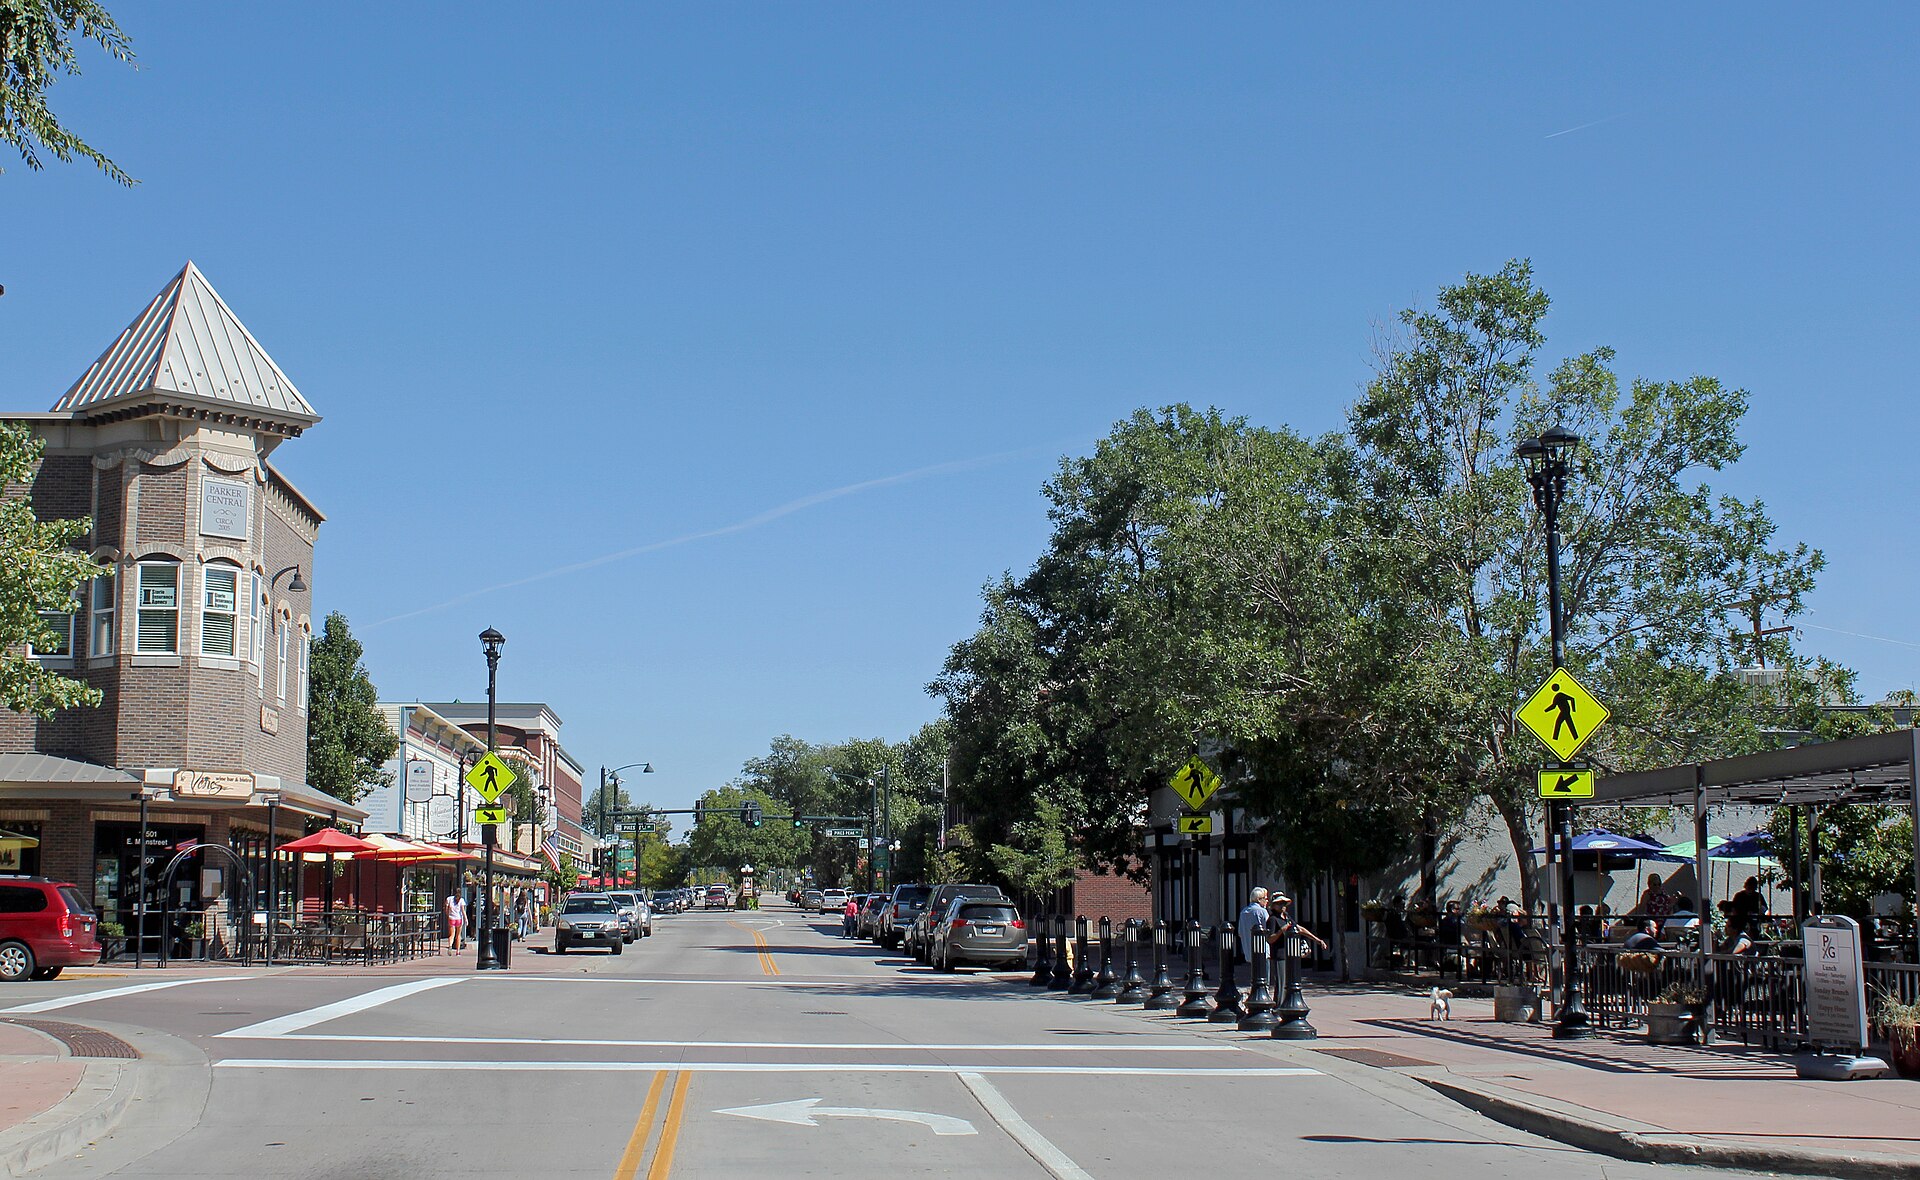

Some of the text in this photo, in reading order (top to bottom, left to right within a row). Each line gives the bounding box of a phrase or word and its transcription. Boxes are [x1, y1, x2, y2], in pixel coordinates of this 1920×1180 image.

[209, 486, 242, 498] PARKER
[206, 495, 245, 507] CENTRAL
[216, 518, 234, 526] CIRCA
[134, 838, 168, 846] Mnstreet
